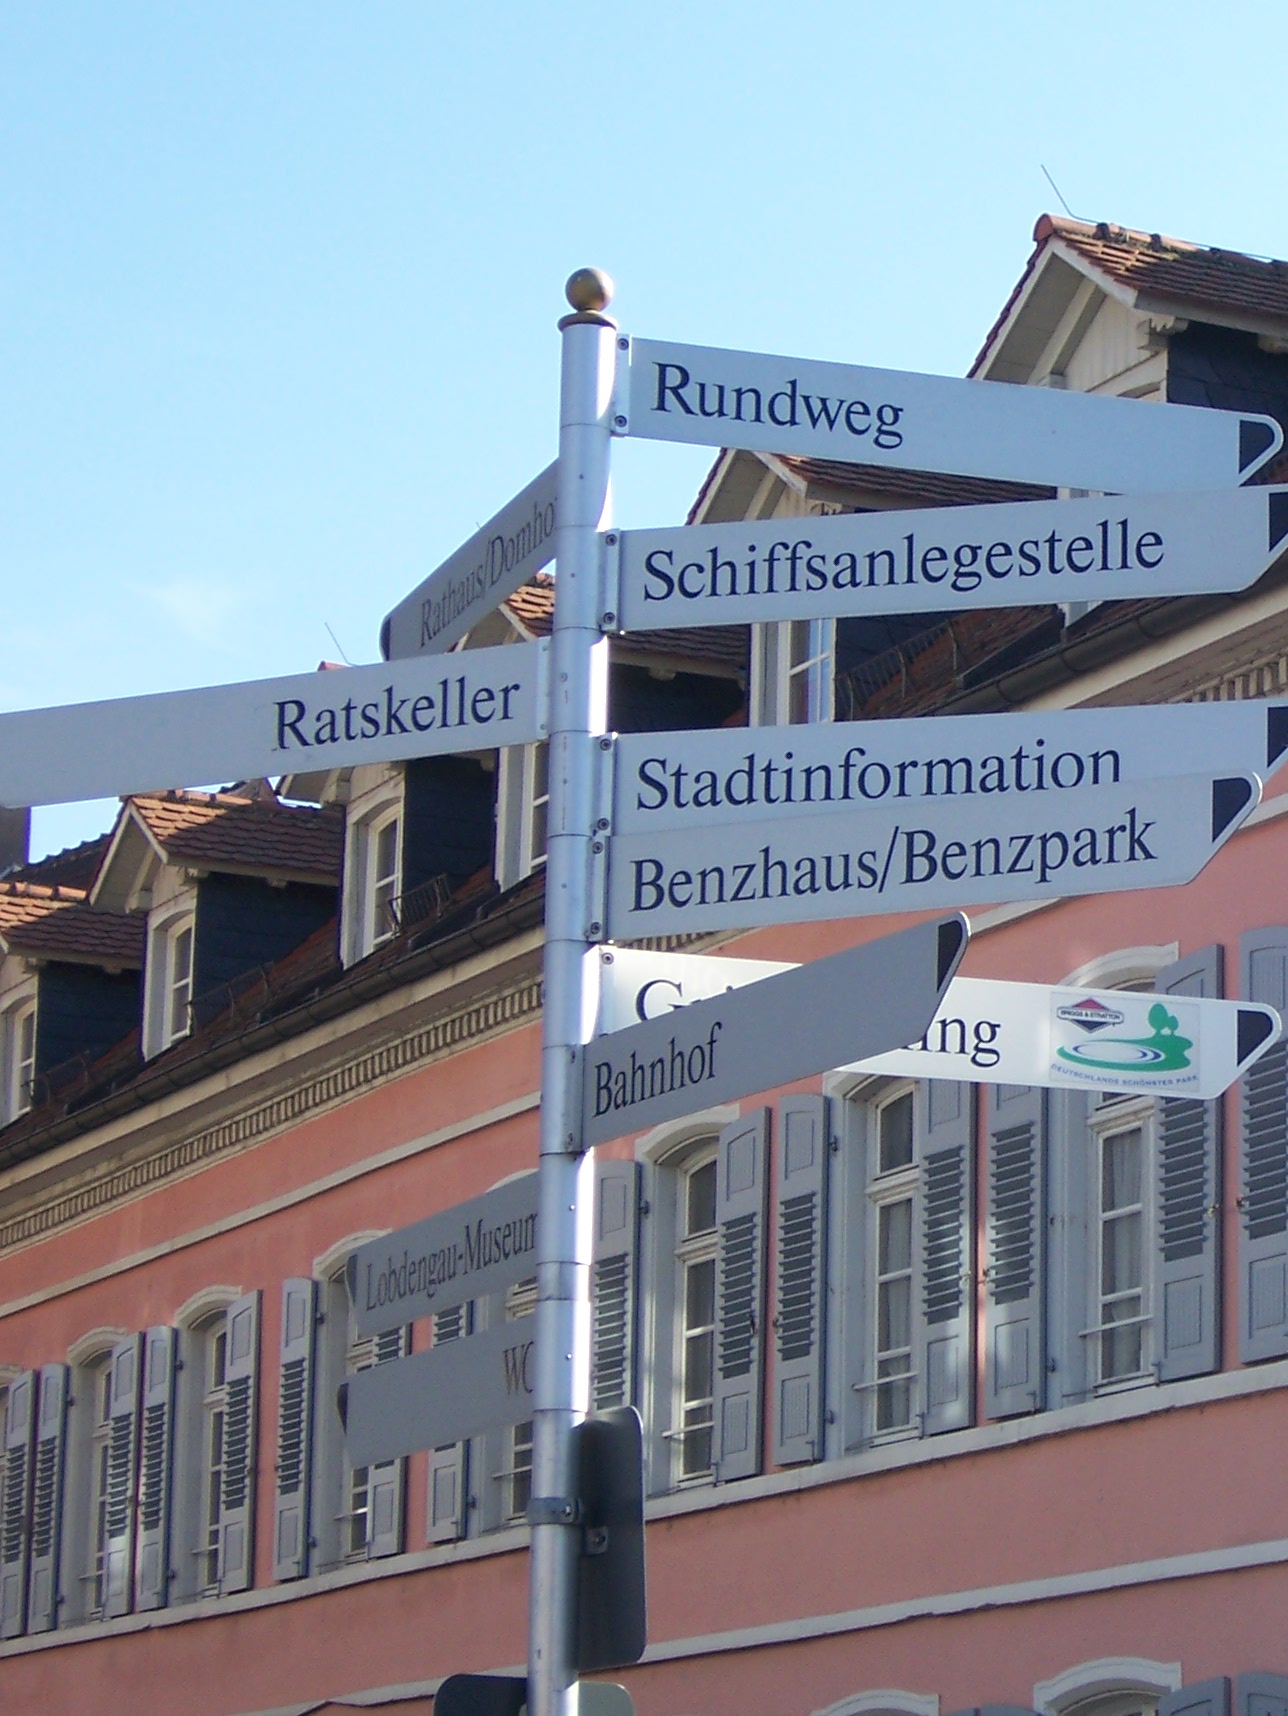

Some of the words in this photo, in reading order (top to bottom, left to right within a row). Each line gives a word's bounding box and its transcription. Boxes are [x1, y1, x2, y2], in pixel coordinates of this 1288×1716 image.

[650, 361, 904, 449] Rundweg
[420, 497, 557, 647] Rathaus/Domho
[643, 518, 1164, 601] Schiffsanlegestelle
[272, 676, 521, 751] Ratskeller
[635, 738, 1121, 811] Stadtinformation
[629, 808, 1158, 914] Benzhaus/Benzpark
[593, 1021, 722, 1118] Bahnhof
